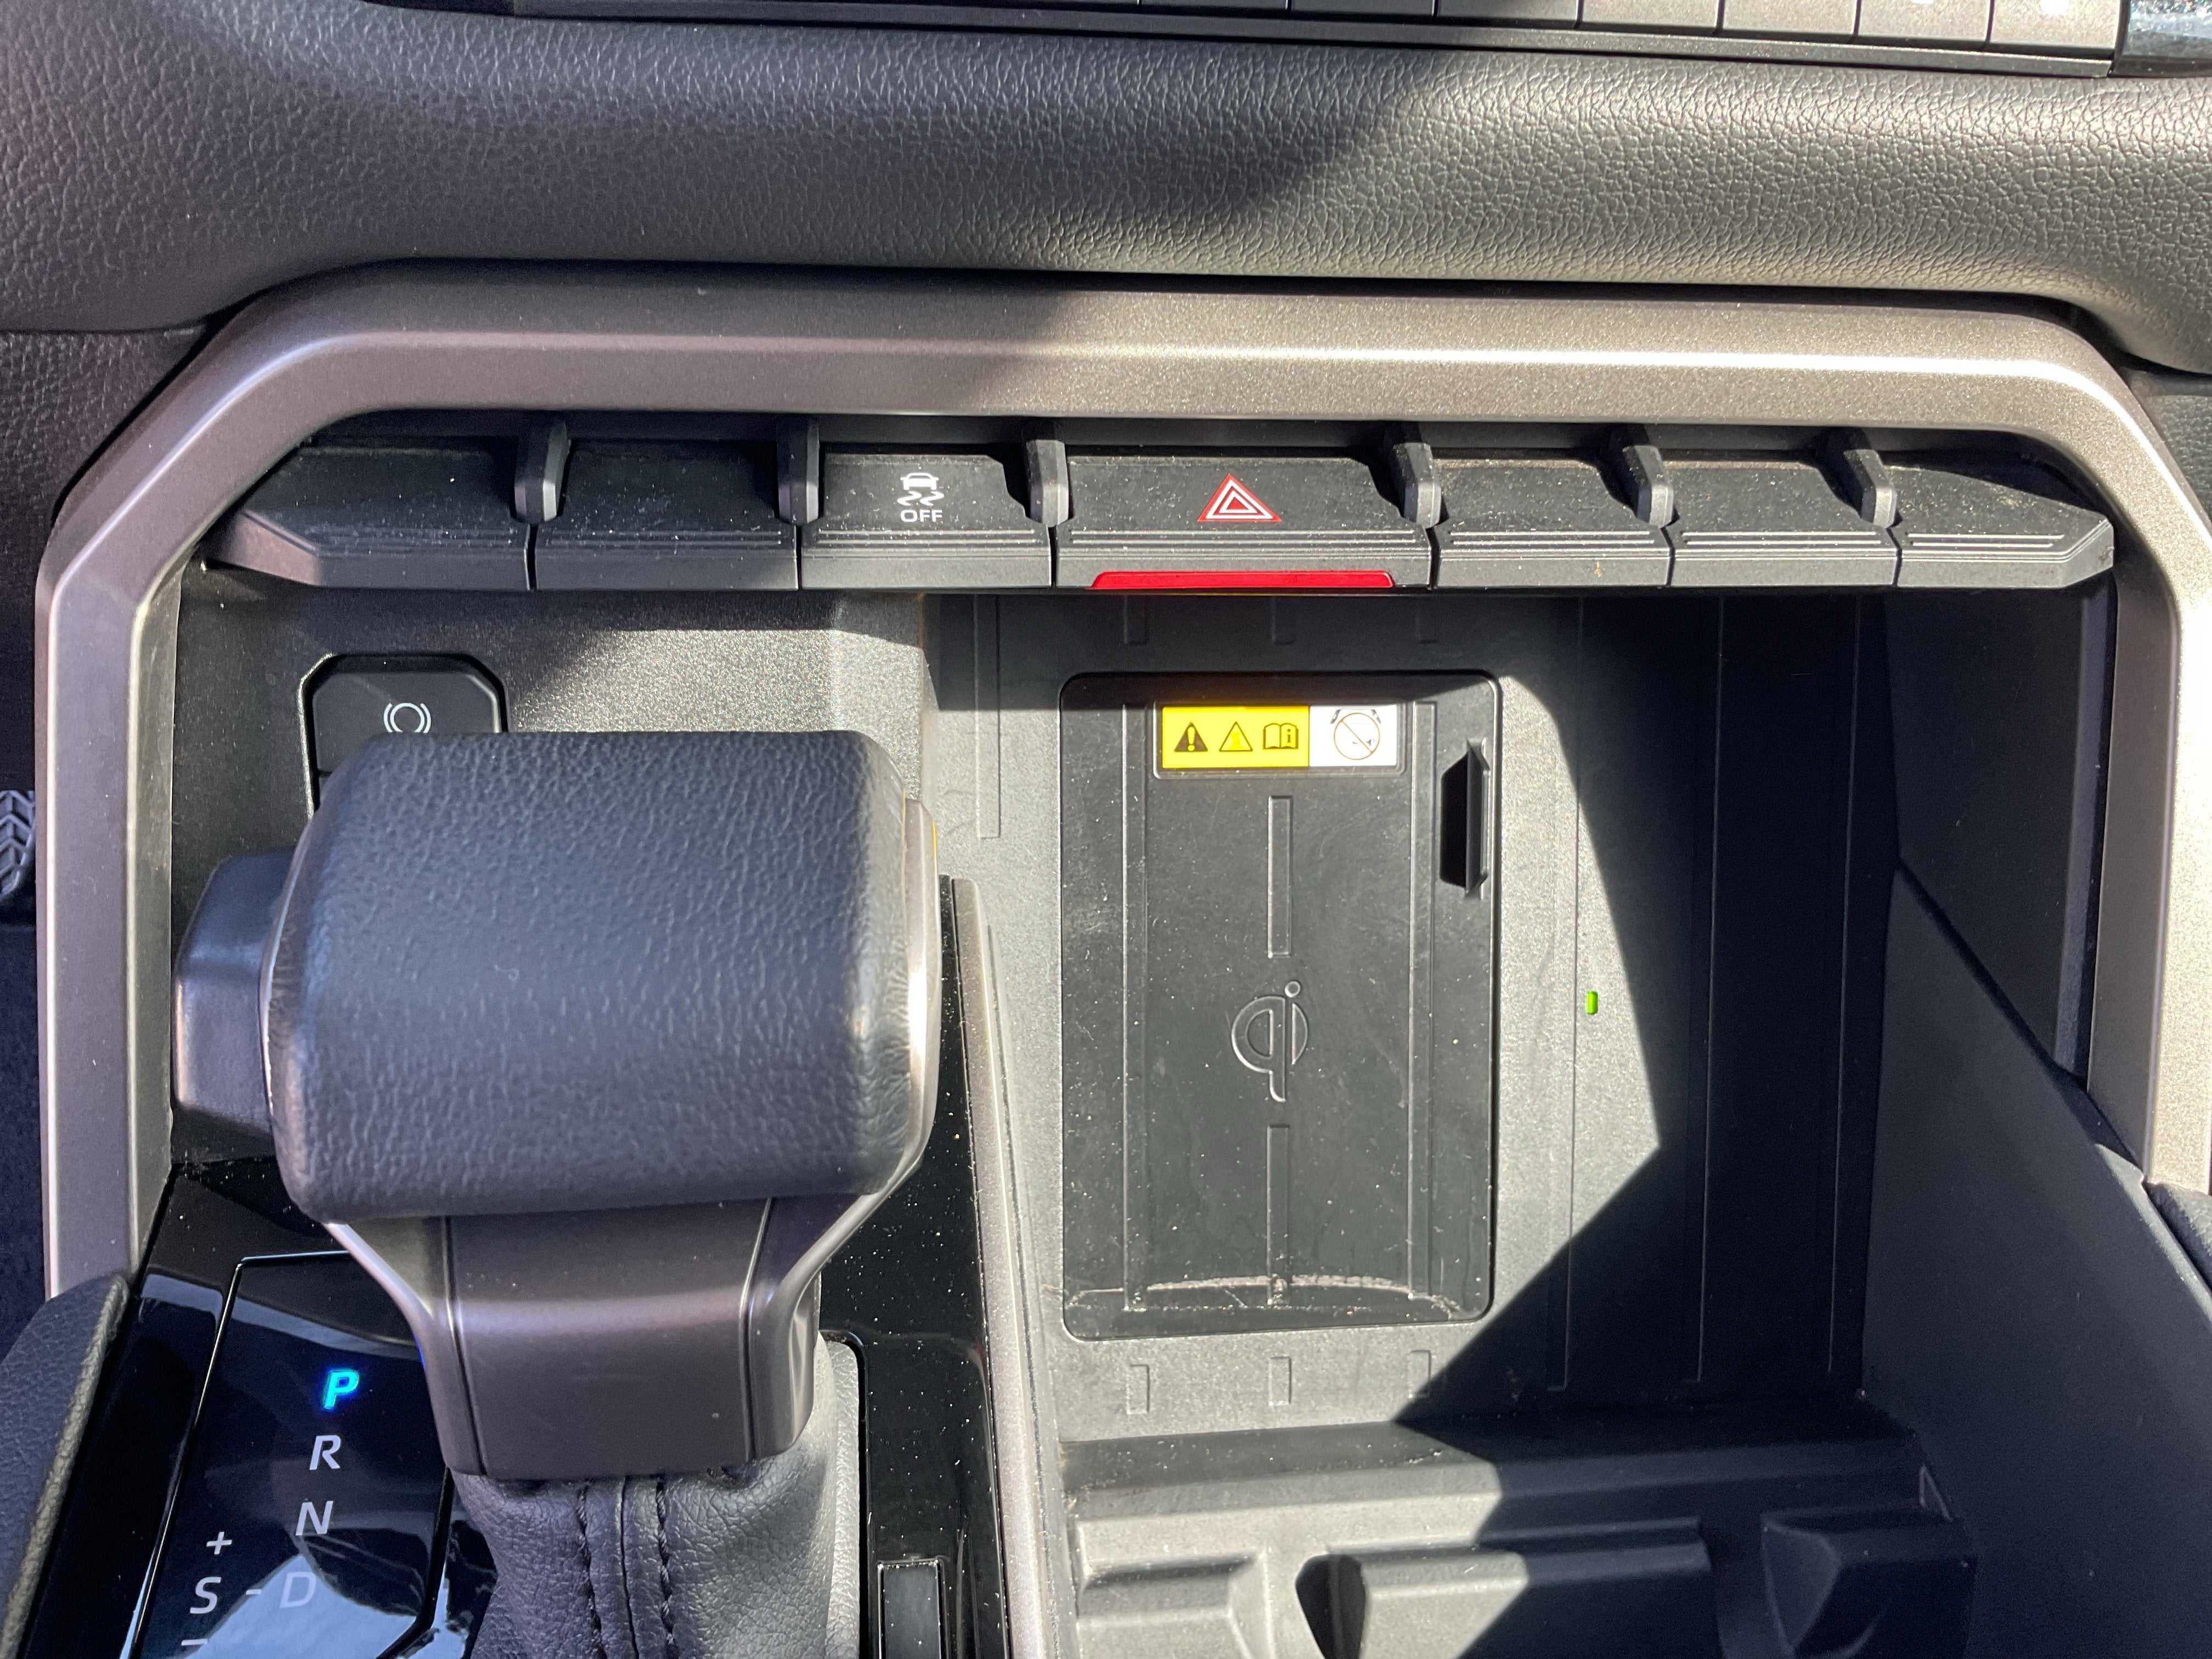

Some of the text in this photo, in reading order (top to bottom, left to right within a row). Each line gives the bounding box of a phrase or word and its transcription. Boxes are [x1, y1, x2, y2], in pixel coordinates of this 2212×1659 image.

[900, 509, 943, 522] OFF
[323, 1368, 359, 1409] P
[309, 1435, 341, 1471] R
[295, 1500, 334, 1536] N
[190, 1571, 316, 1615] S D
